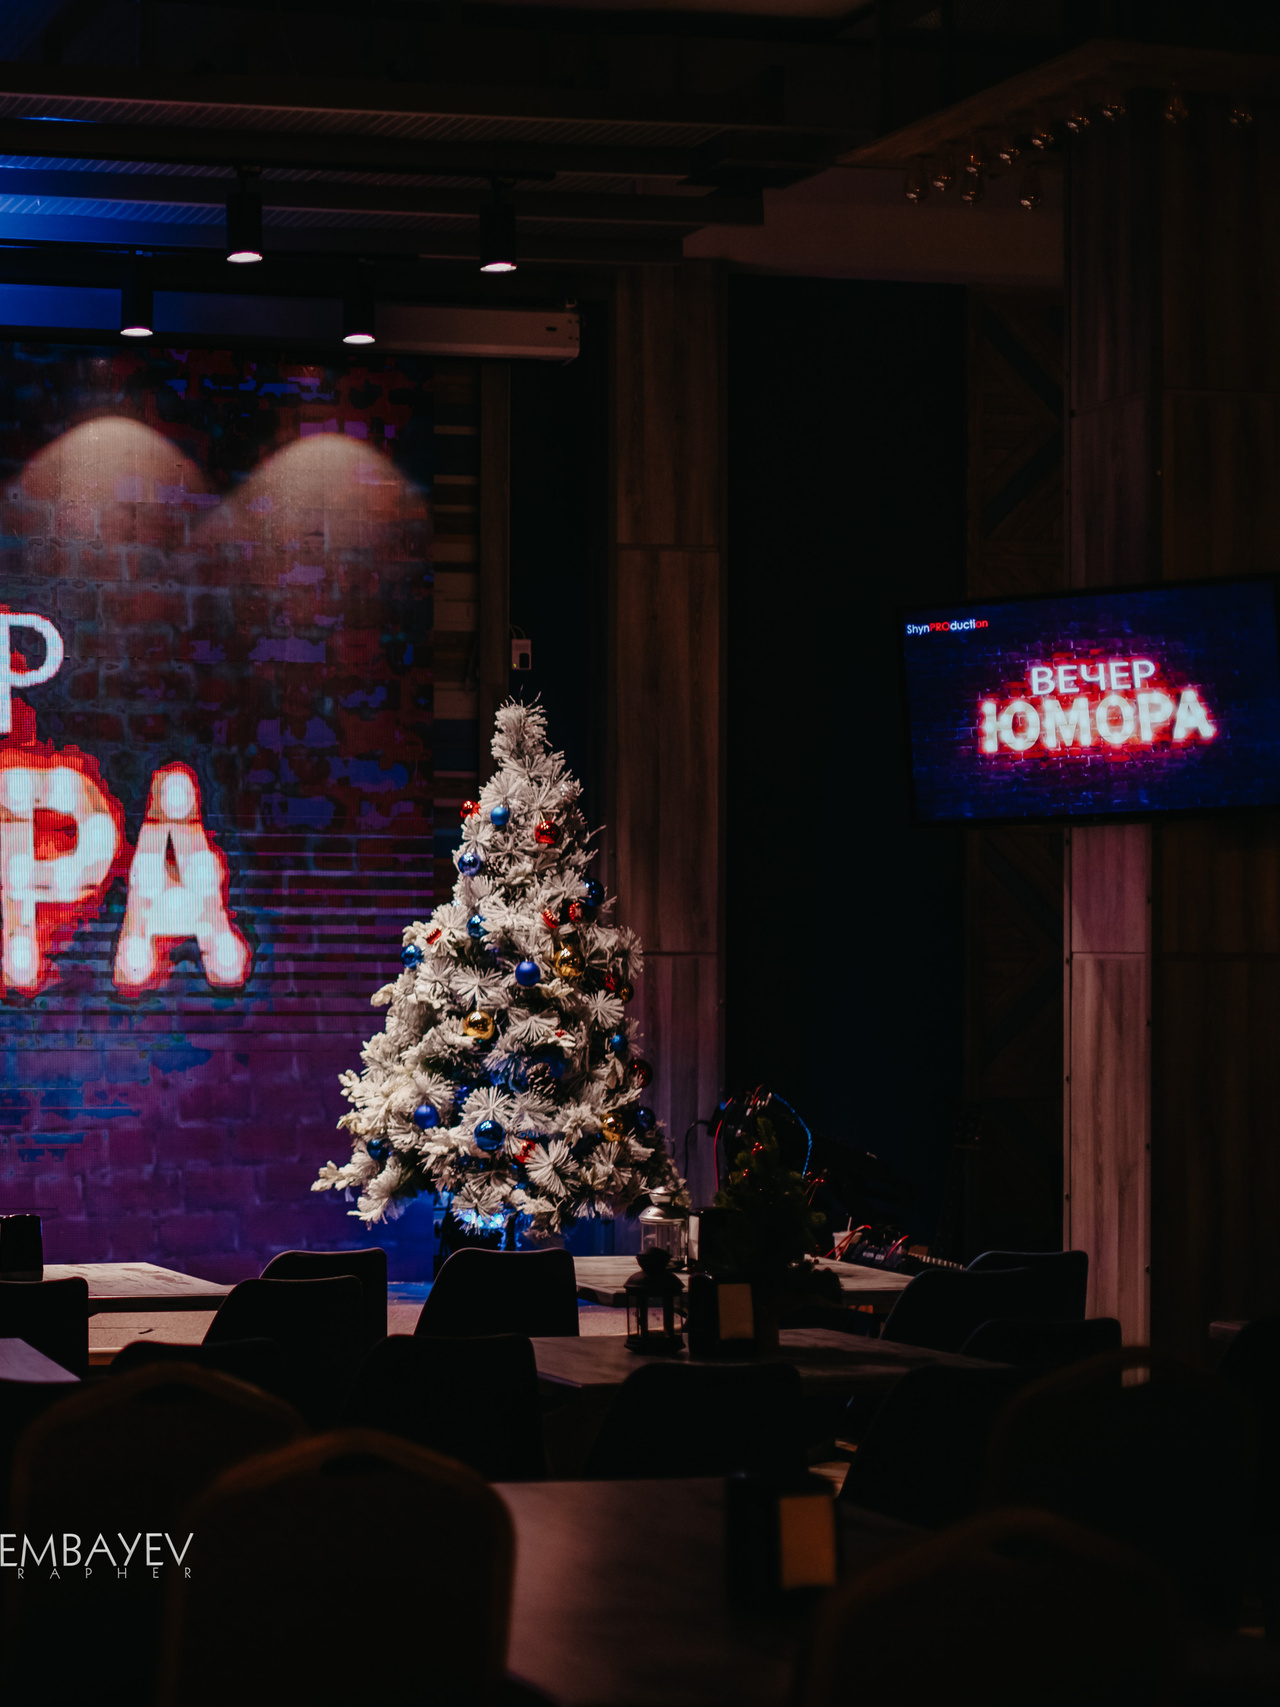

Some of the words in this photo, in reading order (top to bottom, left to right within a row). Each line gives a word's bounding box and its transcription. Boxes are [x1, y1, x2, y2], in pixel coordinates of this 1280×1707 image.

[906, 618, 989, 636] ShynPROduction
[1032, 660, 1155, 695] ВЕЧЕР
[981, 690, 1216, 752] ЮМОРА
